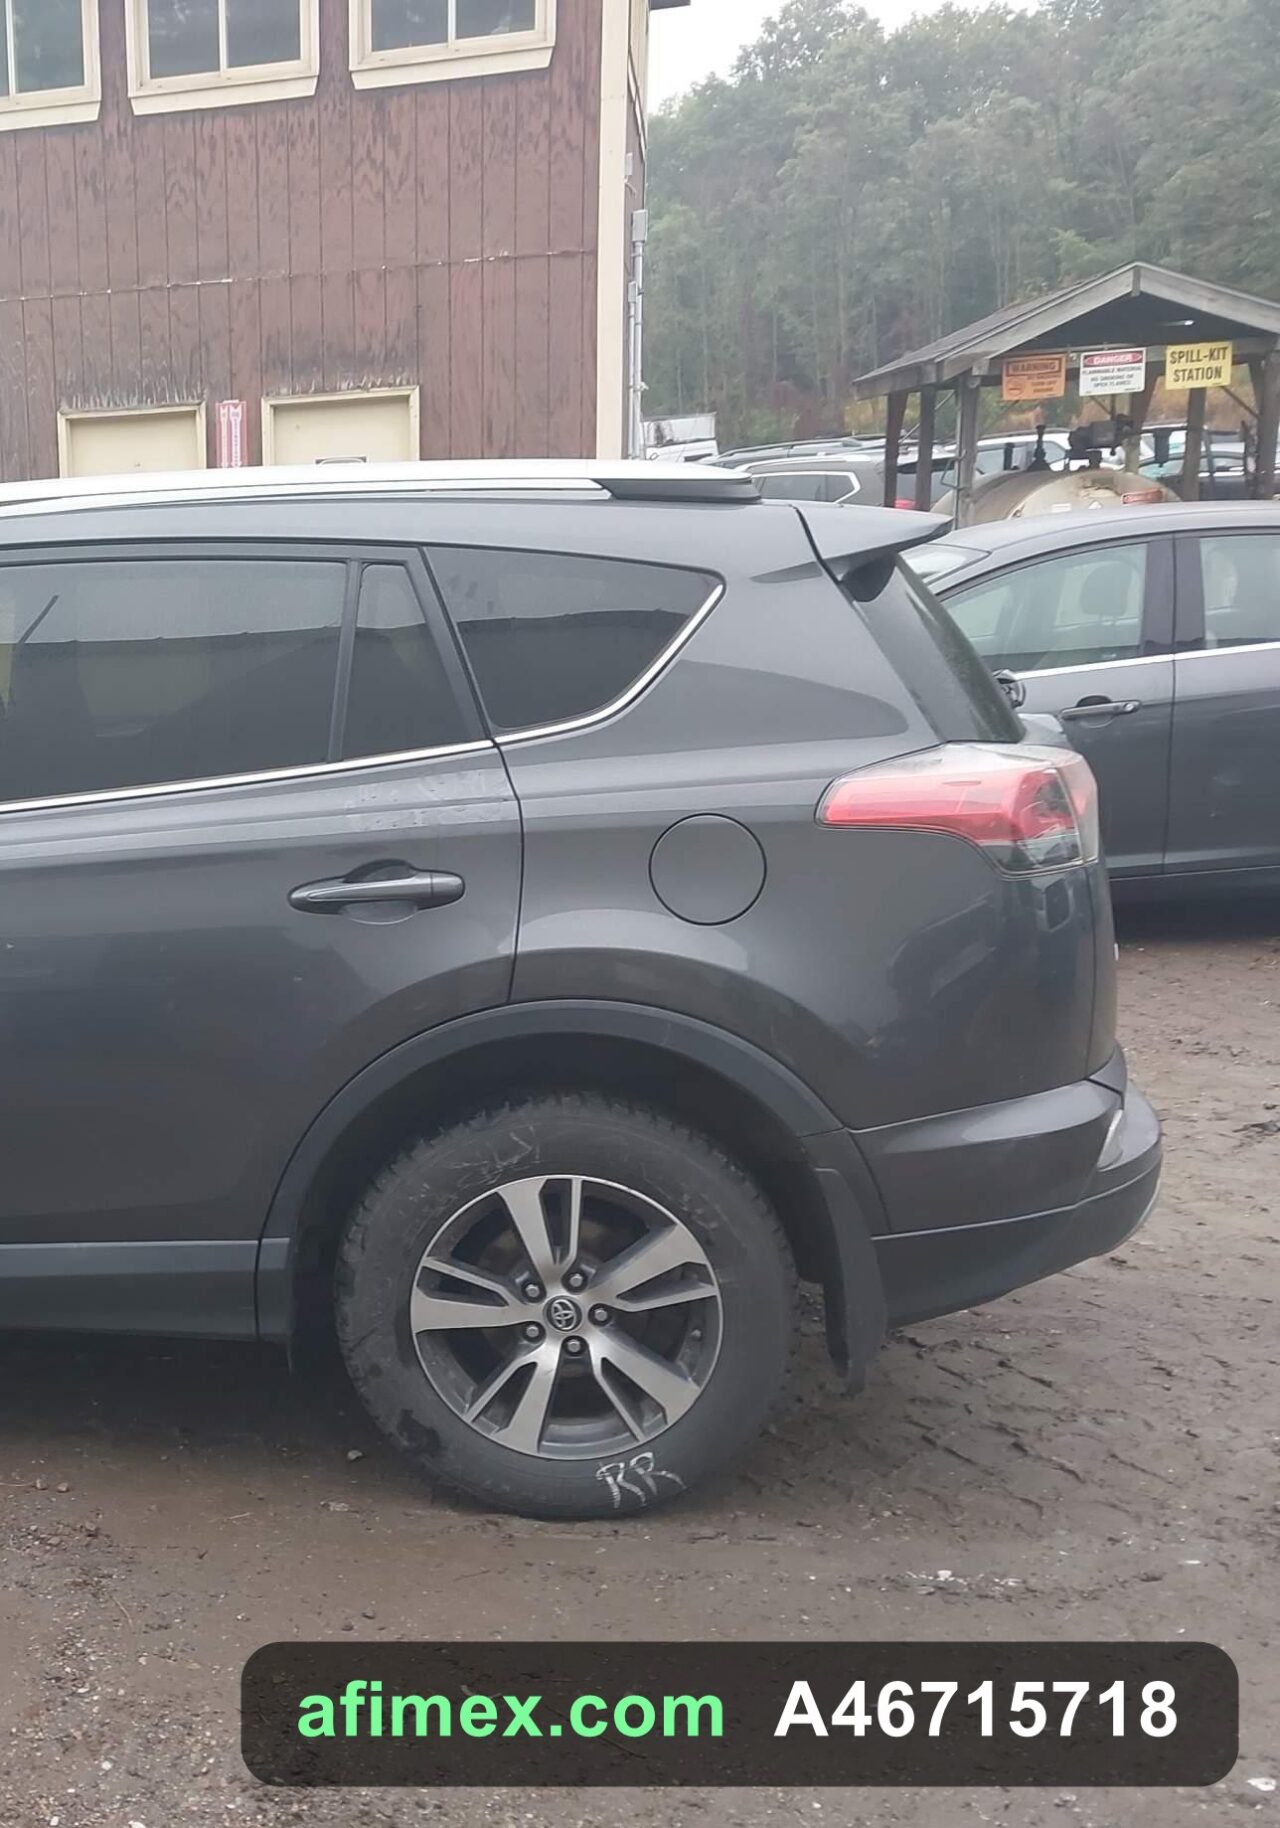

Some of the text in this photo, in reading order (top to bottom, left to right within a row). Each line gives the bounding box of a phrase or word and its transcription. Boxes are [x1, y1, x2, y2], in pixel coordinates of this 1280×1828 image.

[1093, 354, 1133, 366] DANGER
[1170, 346, 1228, 364] SPILL-KIT
[1011, 361, 1057, 373] WARNING
[1173, 366, 1223, 383] STATION
